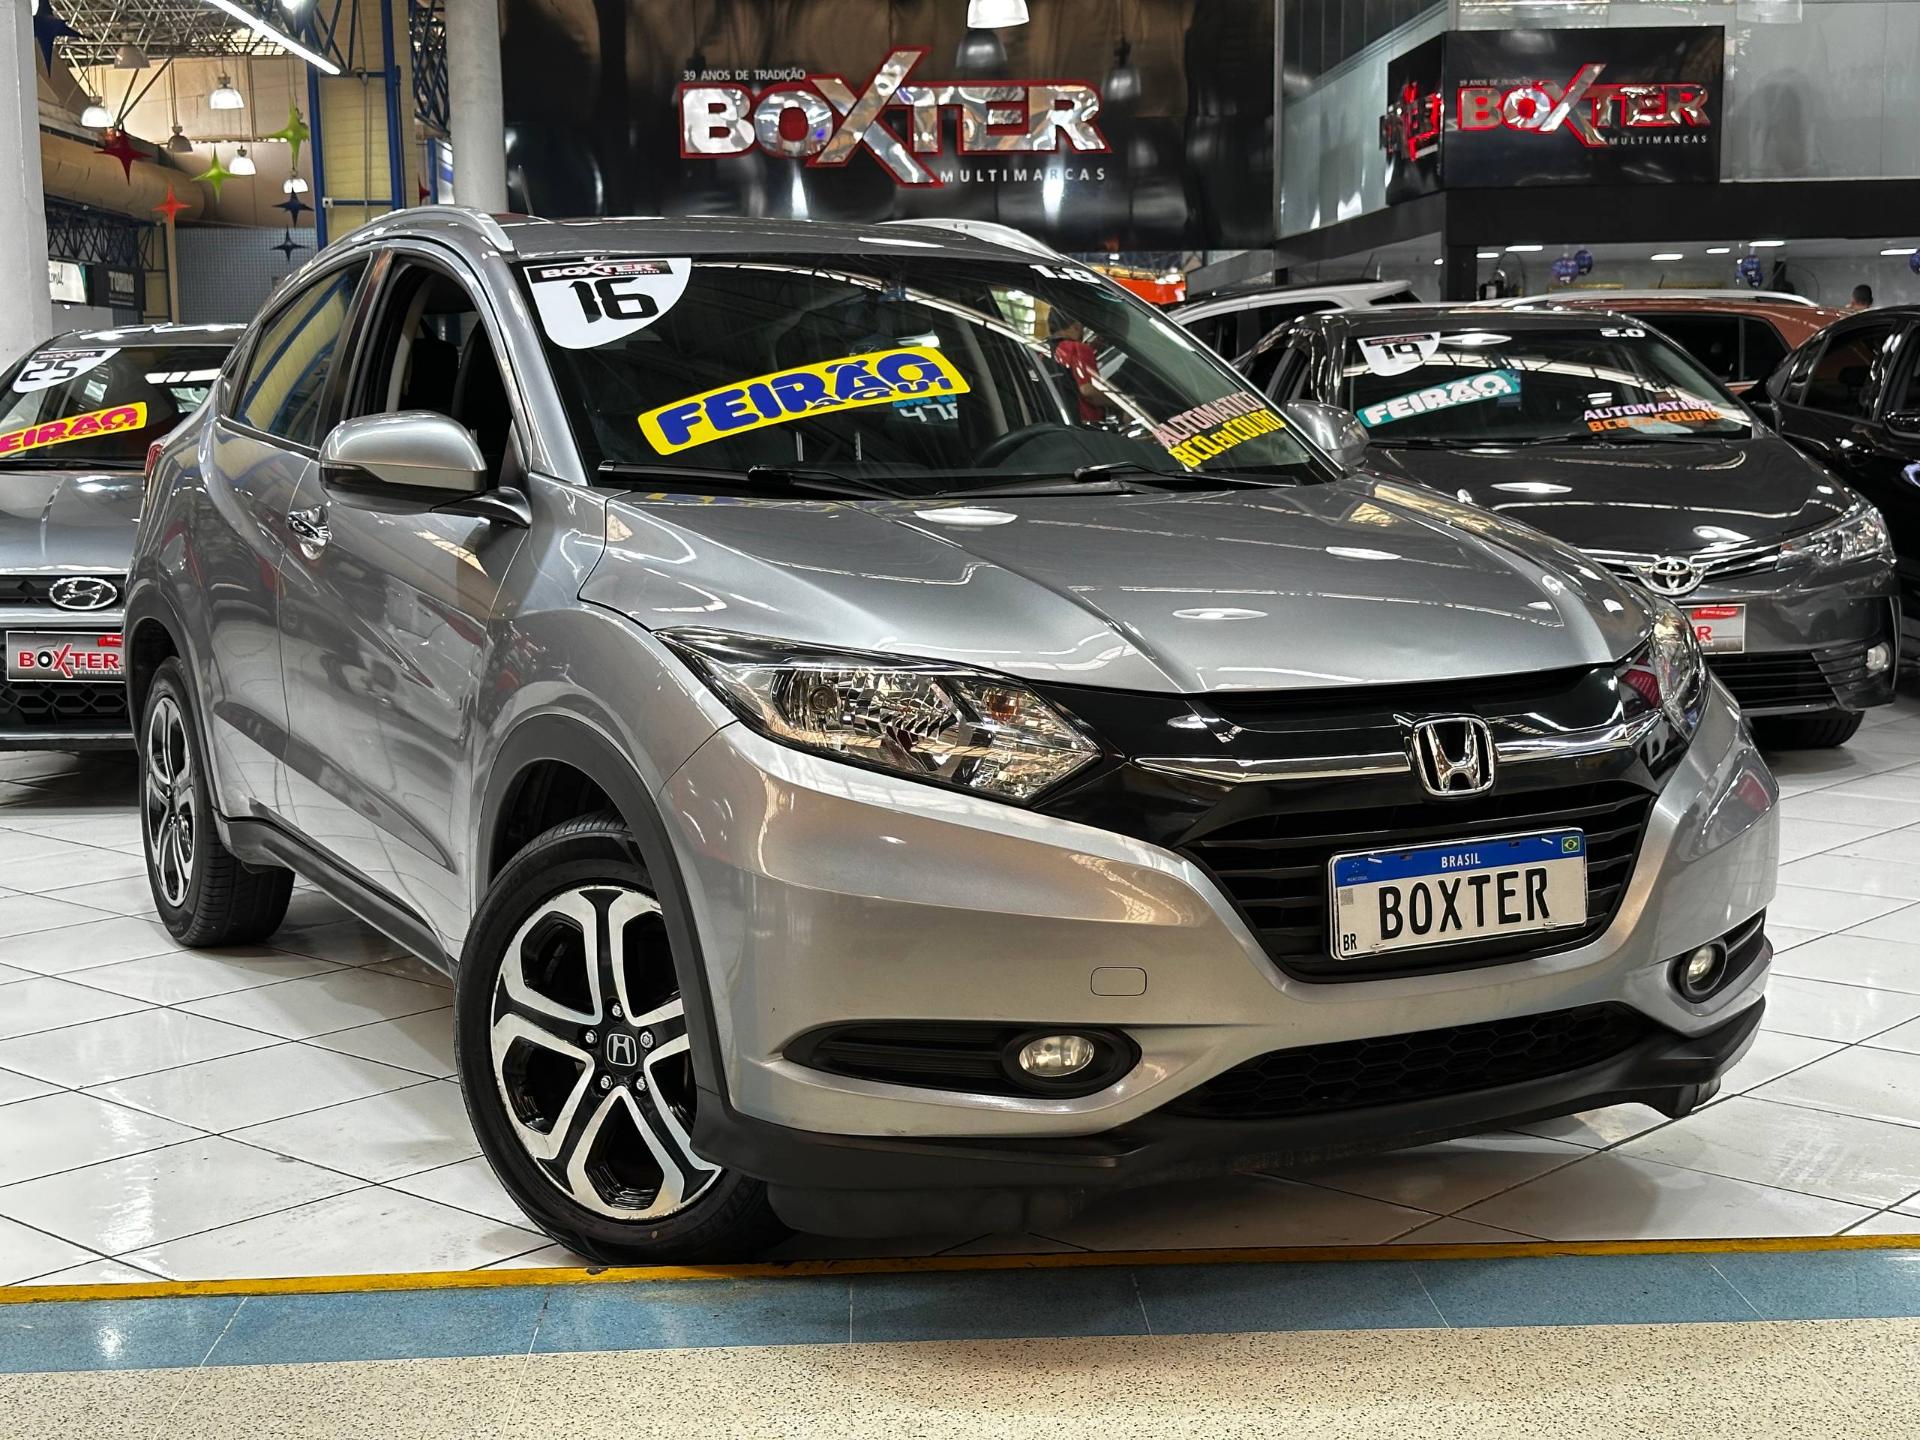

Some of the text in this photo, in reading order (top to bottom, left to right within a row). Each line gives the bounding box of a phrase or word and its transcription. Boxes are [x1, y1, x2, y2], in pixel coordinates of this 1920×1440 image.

[683, 67, 807, 83] 39 ANOS DE TRADIÇÃO
[1469, 78, 1488, 87] ANOS
[1458, 63, 1711, 147] BOXTER
[681, 48, 1110, 187] BOXTER
[1609, 134, 1708, 146] MULTIMARCAS
[940, 167, 1106, 183] MULTIMARCAS
[541, 262, 654, 279] BOXTER
[1028, 264, 1101, 284] 1.8
[568, 276, 660, 324] 16
[1600, 327, 1647, 339] 2.0
[1380, 342, 1424, 362] 19
[20, 358, 80, 383] 25
[656, 352, 944, 447] FEIRÃO
[1364, 374, 1508, 425] FEIRÃO
[0, 407, 138, 454] EIRÃO
[1222, 408, 1287, 441] COURO
[17, 642, 121, 679] BOXTER
[1441, 851, 1482, 869] BRASIL
[1378, 866, 1551, 941] BOXTER
[1343, 933, 1358, 952] BR
